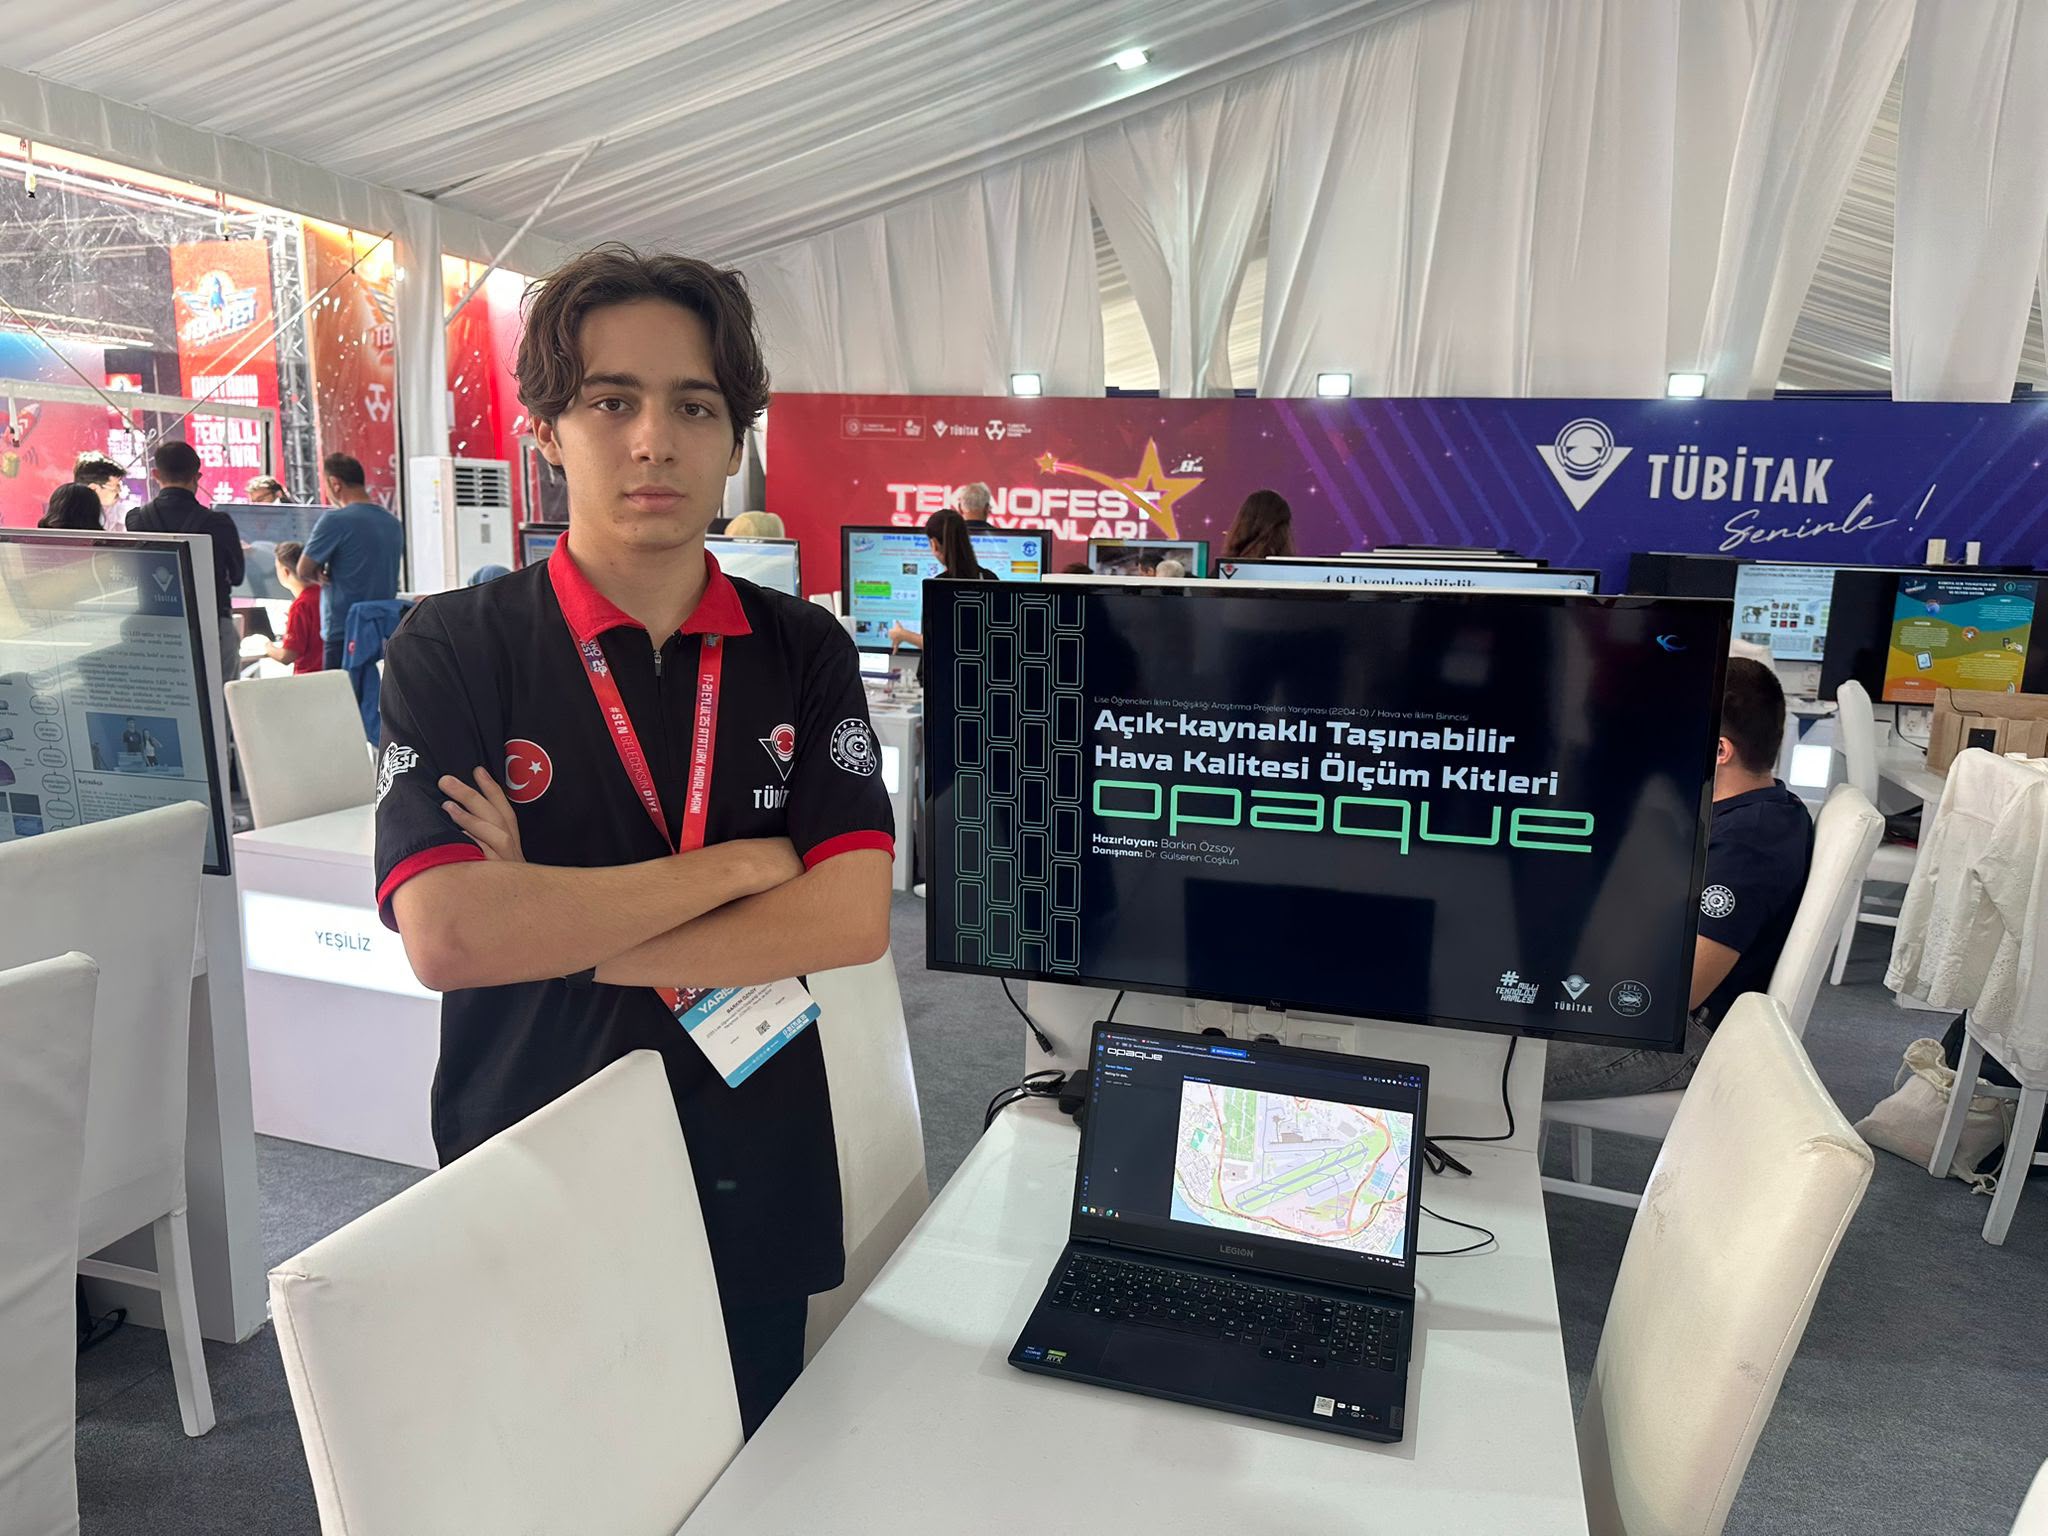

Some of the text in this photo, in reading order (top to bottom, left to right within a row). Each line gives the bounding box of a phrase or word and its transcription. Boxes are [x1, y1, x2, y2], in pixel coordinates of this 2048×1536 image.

[1648, 445, 1834, 504] TÜBİTAK
[1094, 709, 1515, 754] Açık-kaynaklı Taşınabilir
[1095, 745, 1559, 796] Hava Kalitesi Ölçüm Kitleri
[1093, 779, 1595, 855] opaque
[1092, 833, 1235, 855] Hazırlayan: Barkın Özsoy
[1092, 845, 1143, 858] Danışman:
[1160, 850, 1202, 862] Gülseren
[1204, 854, 1240, 866] Coşkun
[315, 931, 371, 951] YEŞİLİZ
[1554, 1001, 1593, 1013] TÜBİTAK
[1107, 1047, 1163, 1062] opaque
[1220, 1245, 1254, 1258] LEGION
